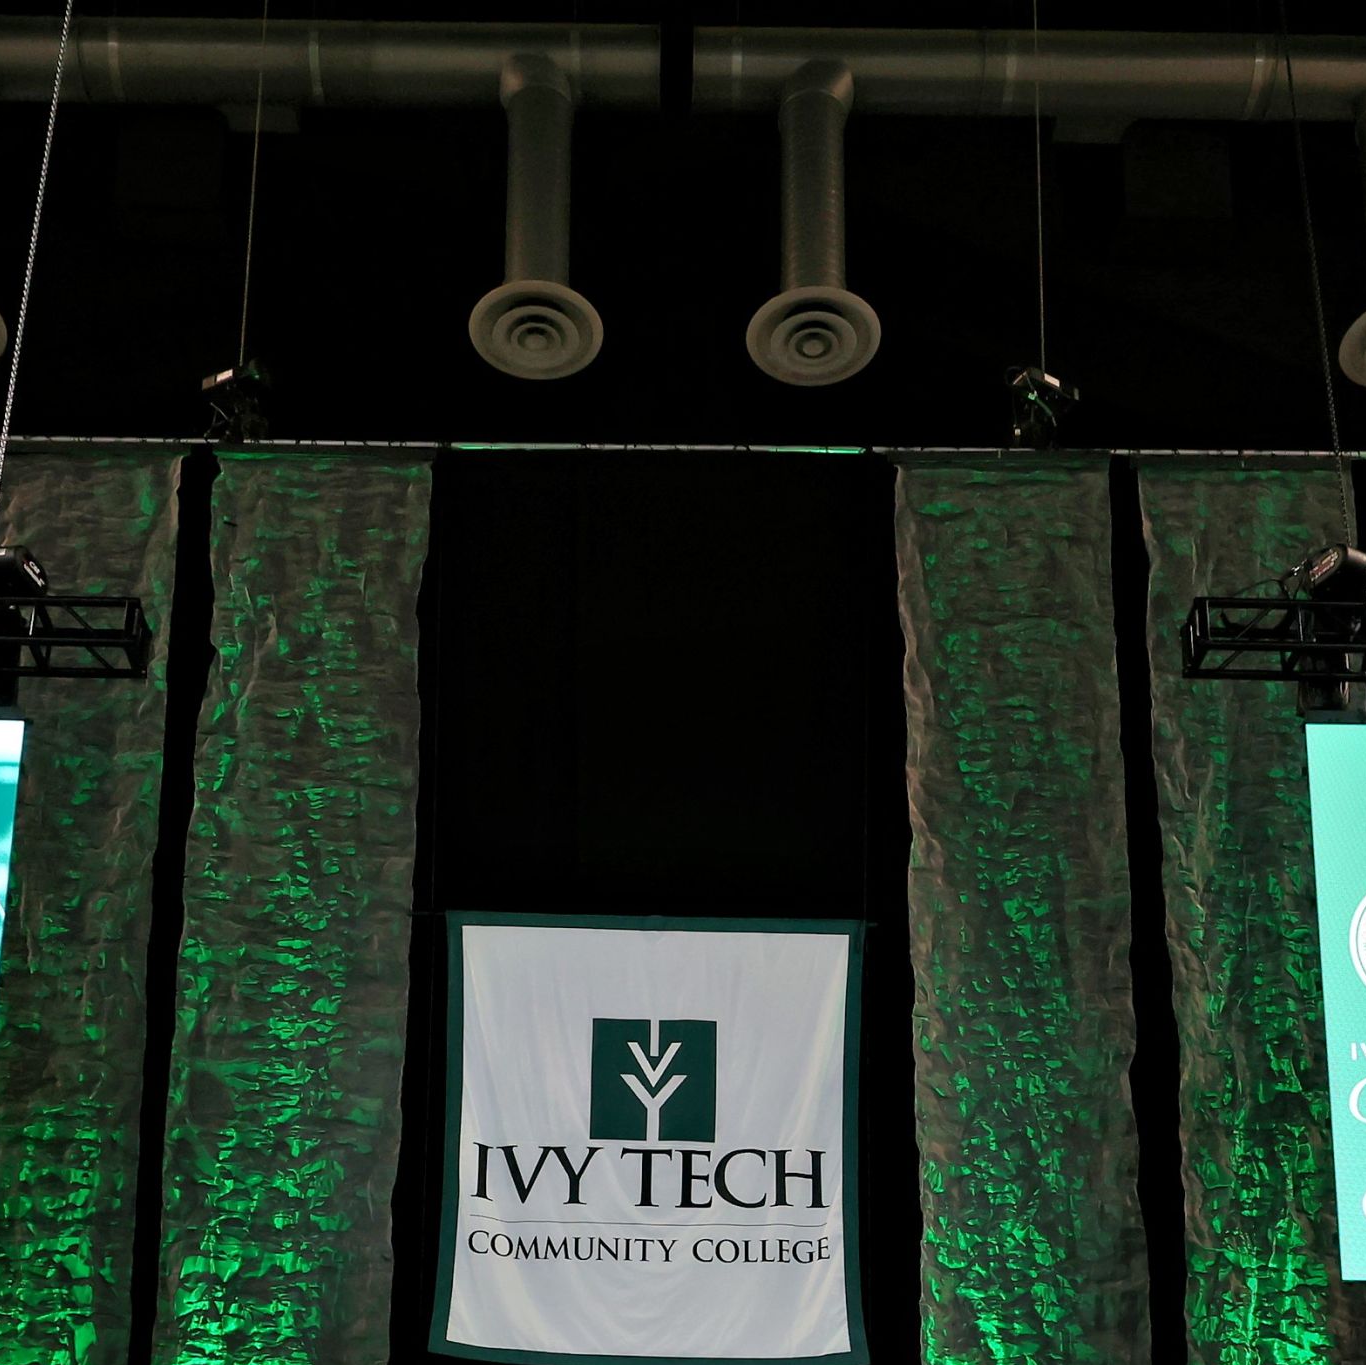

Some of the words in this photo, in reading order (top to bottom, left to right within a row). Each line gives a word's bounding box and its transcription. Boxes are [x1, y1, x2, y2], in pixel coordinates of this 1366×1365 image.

[470, 1142, 604, 1206] IVY
[620, 1146, 831, 1210] TECH
[467, 1229, 677, 1263] COMMUNITY
[691, 1236, 831, 1264] COLLEGE
